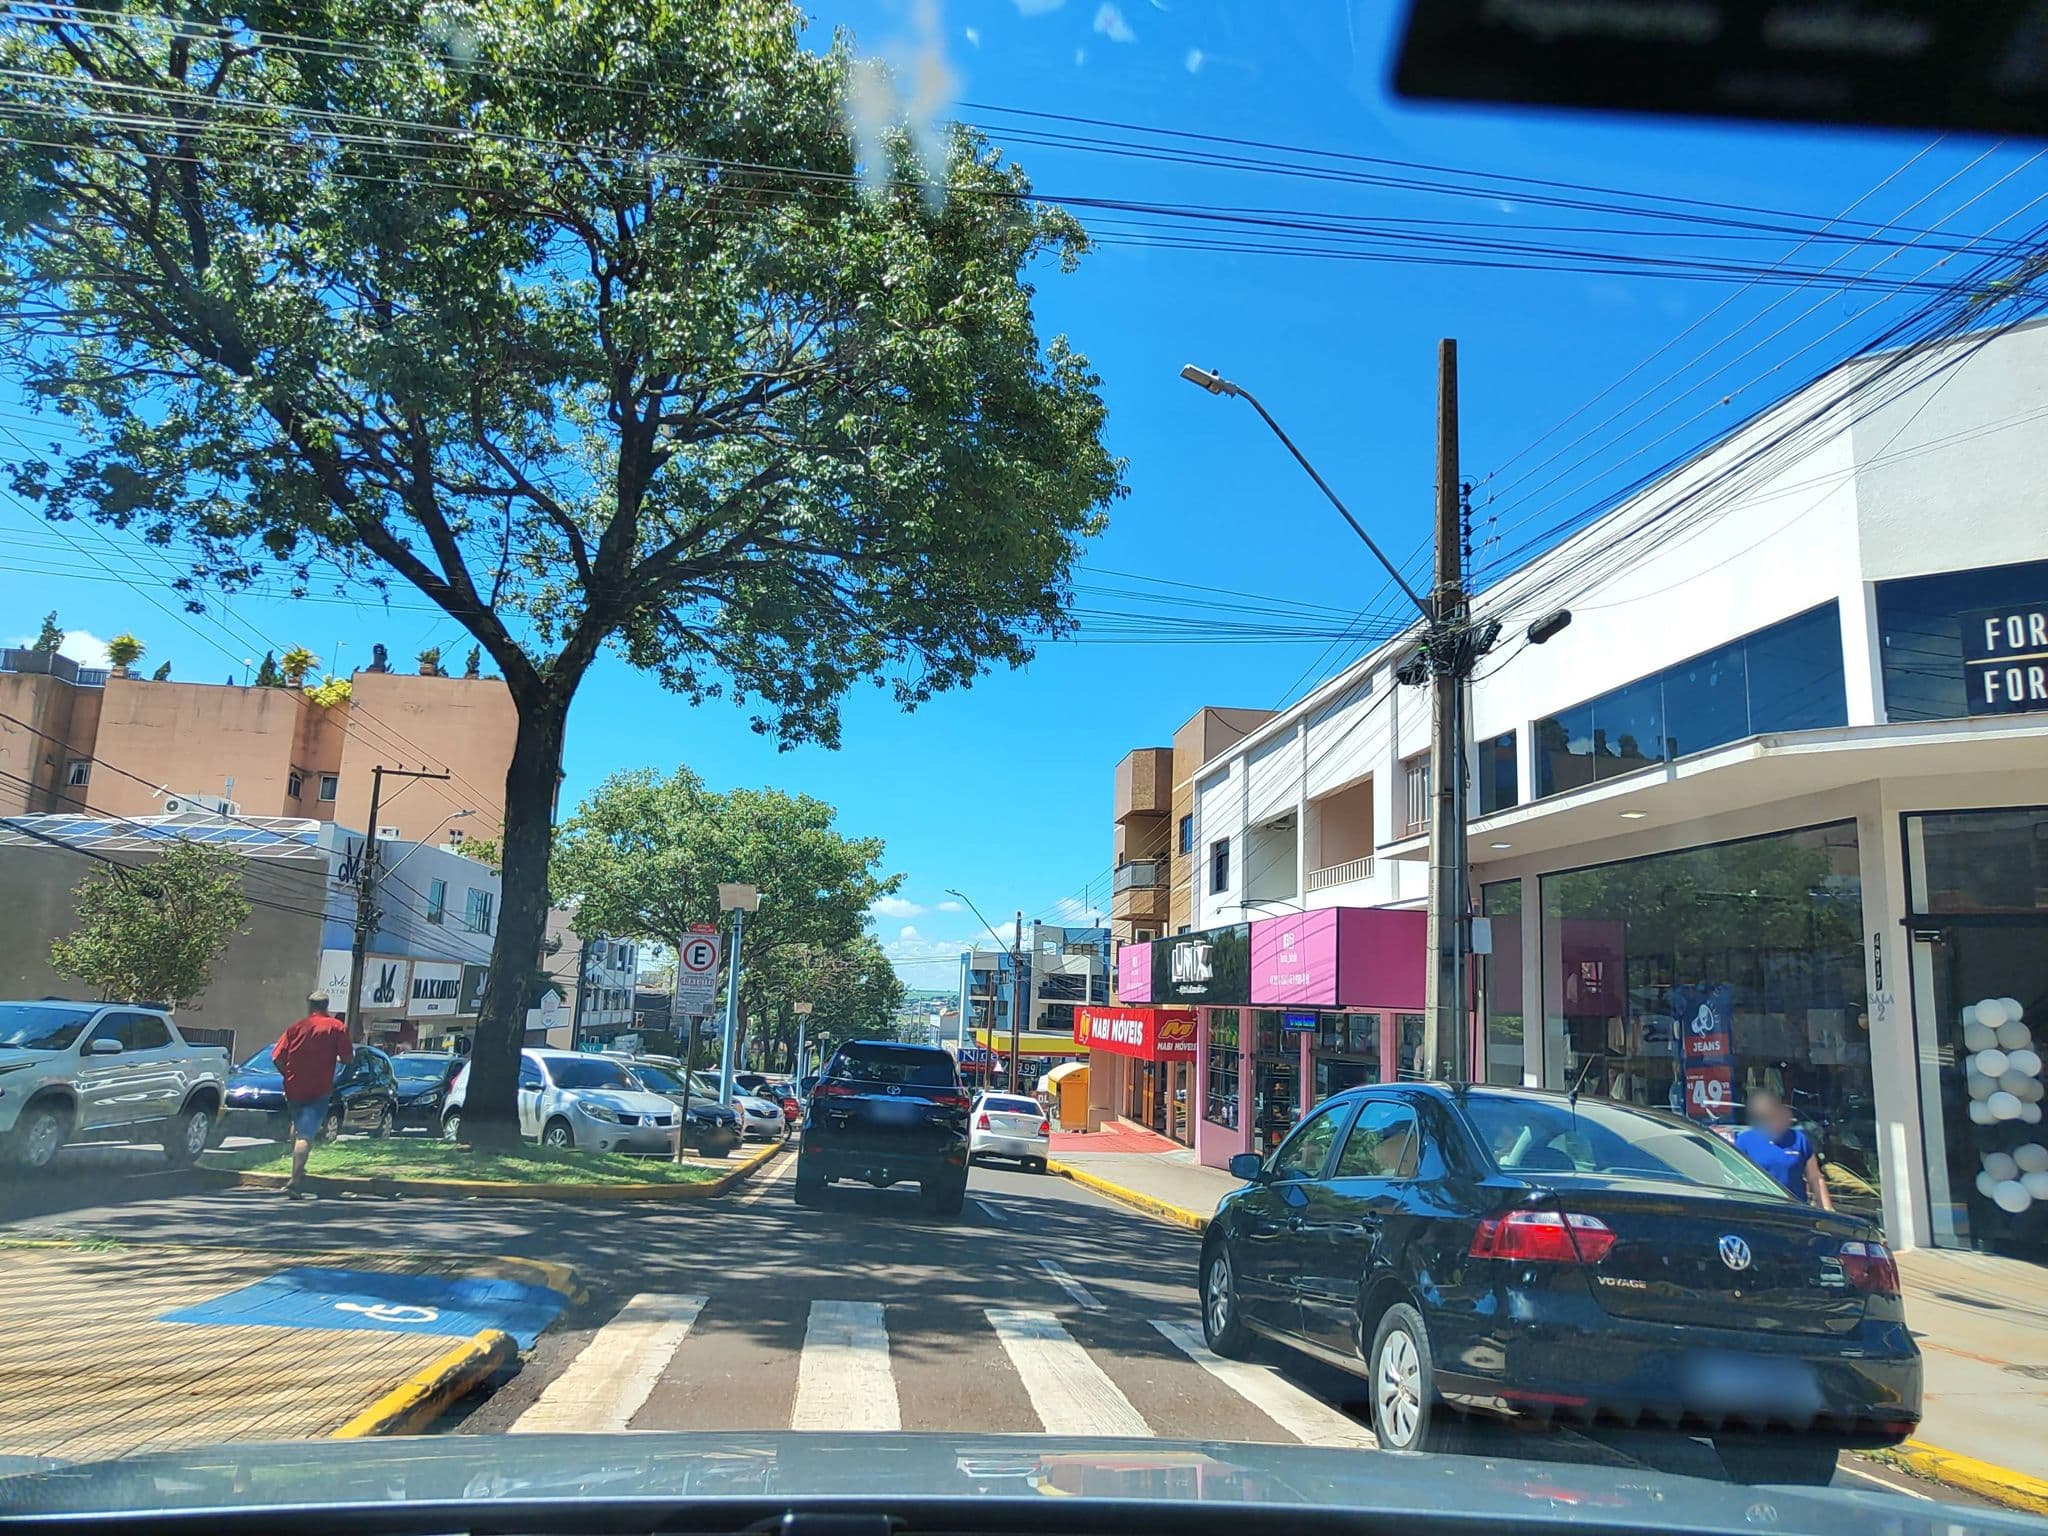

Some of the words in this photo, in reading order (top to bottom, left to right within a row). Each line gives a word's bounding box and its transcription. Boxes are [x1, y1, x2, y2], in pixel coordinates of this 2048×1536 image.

[694, 946, 707, 965] E
[1111, 1013, 1144, 1046] MÓVEIS
[1157, 1042, 1174, 1050] MABI
[1693, 1041, 1720, 1052] JEANS
[1693, 1080, 1722, 1108] 49
[1597, 1276, 1647, 1288] VOYAGE
